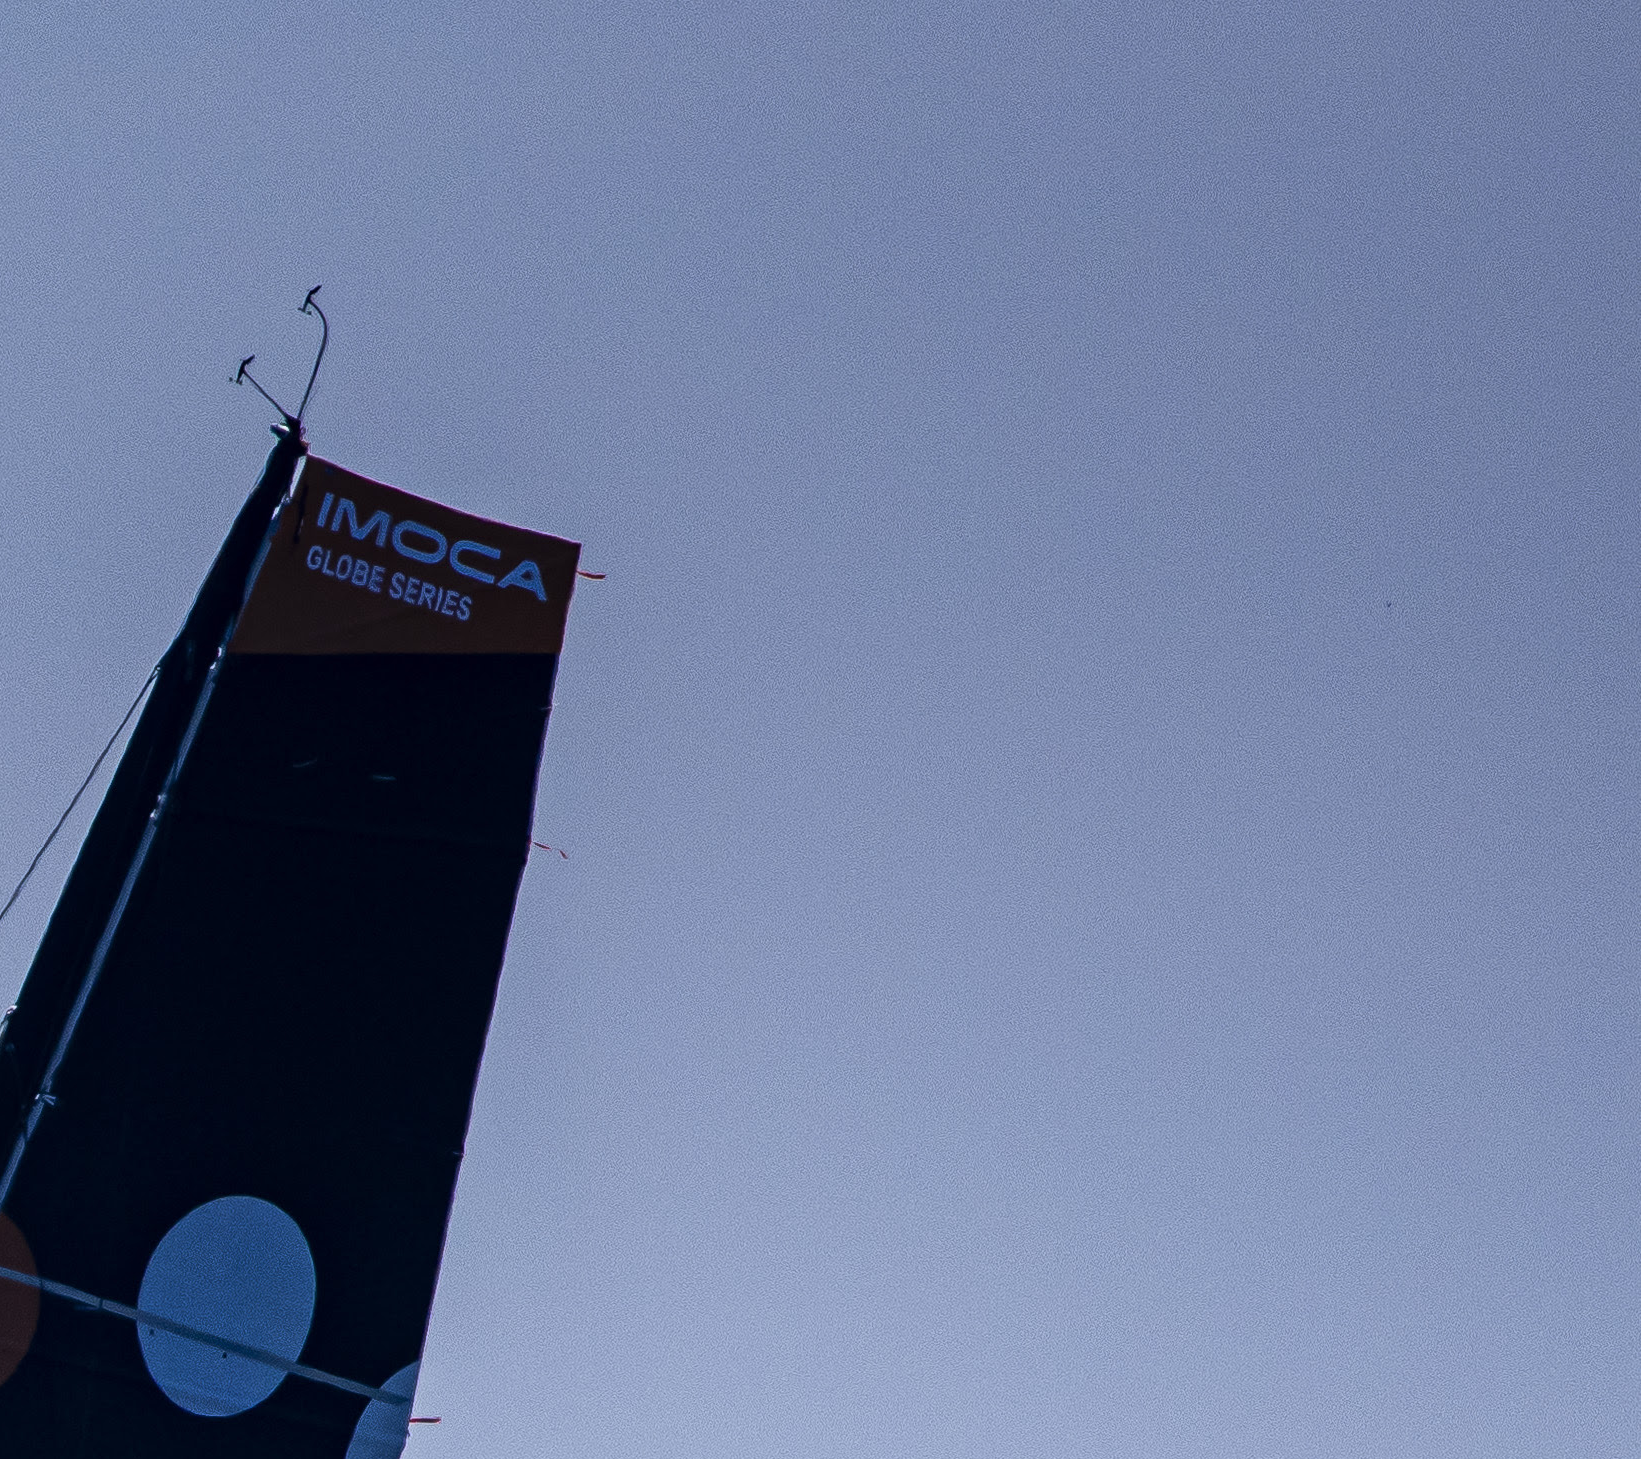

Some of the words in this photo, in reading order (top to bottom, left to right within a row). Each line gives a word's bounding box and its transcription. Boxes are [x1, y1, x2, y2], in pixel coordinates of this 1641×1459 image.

[306, 544, 385, 594] GLOBE
[389, 570, 473, 621] SERIES
[315, 490, 548, 602] IMOCA
